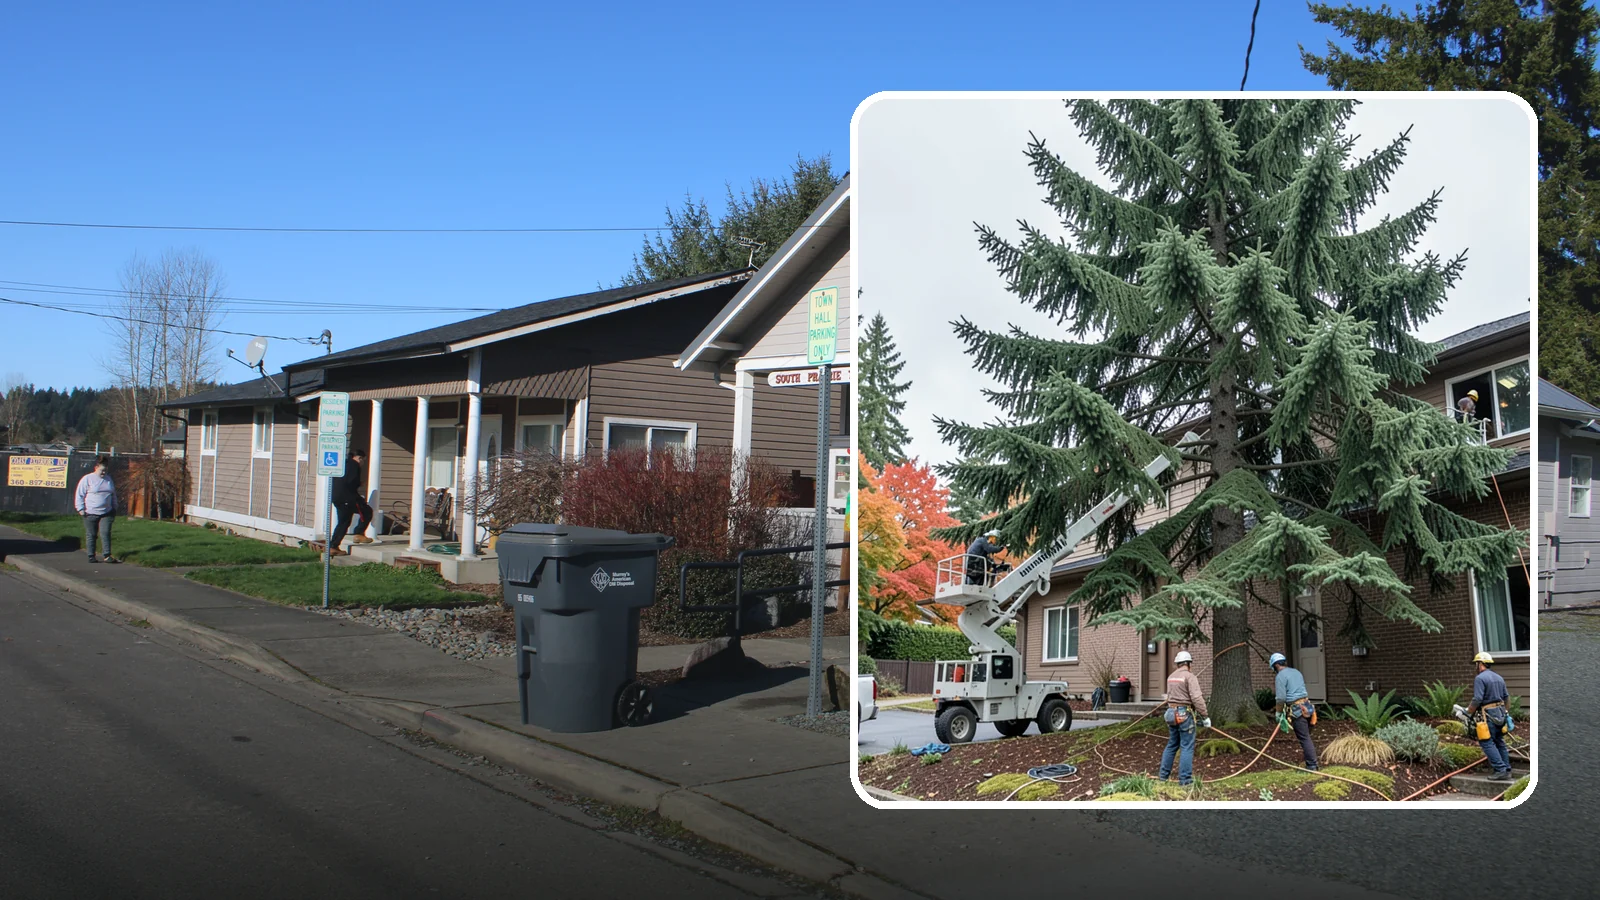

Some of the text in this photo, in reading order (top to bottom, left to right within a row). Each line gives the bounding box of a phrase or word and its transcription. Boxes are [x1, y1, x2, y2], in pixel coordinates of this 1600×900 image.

[815, 294, 833, 308] TOWN
[814, 311, 831, 324] HALL
[810, 326, 836, 341] PARKING
[813, 344, 831, 357] ONLY
[775, 373, 801, 384] SOUTH
[807, 370, 842, 382] PRIE
